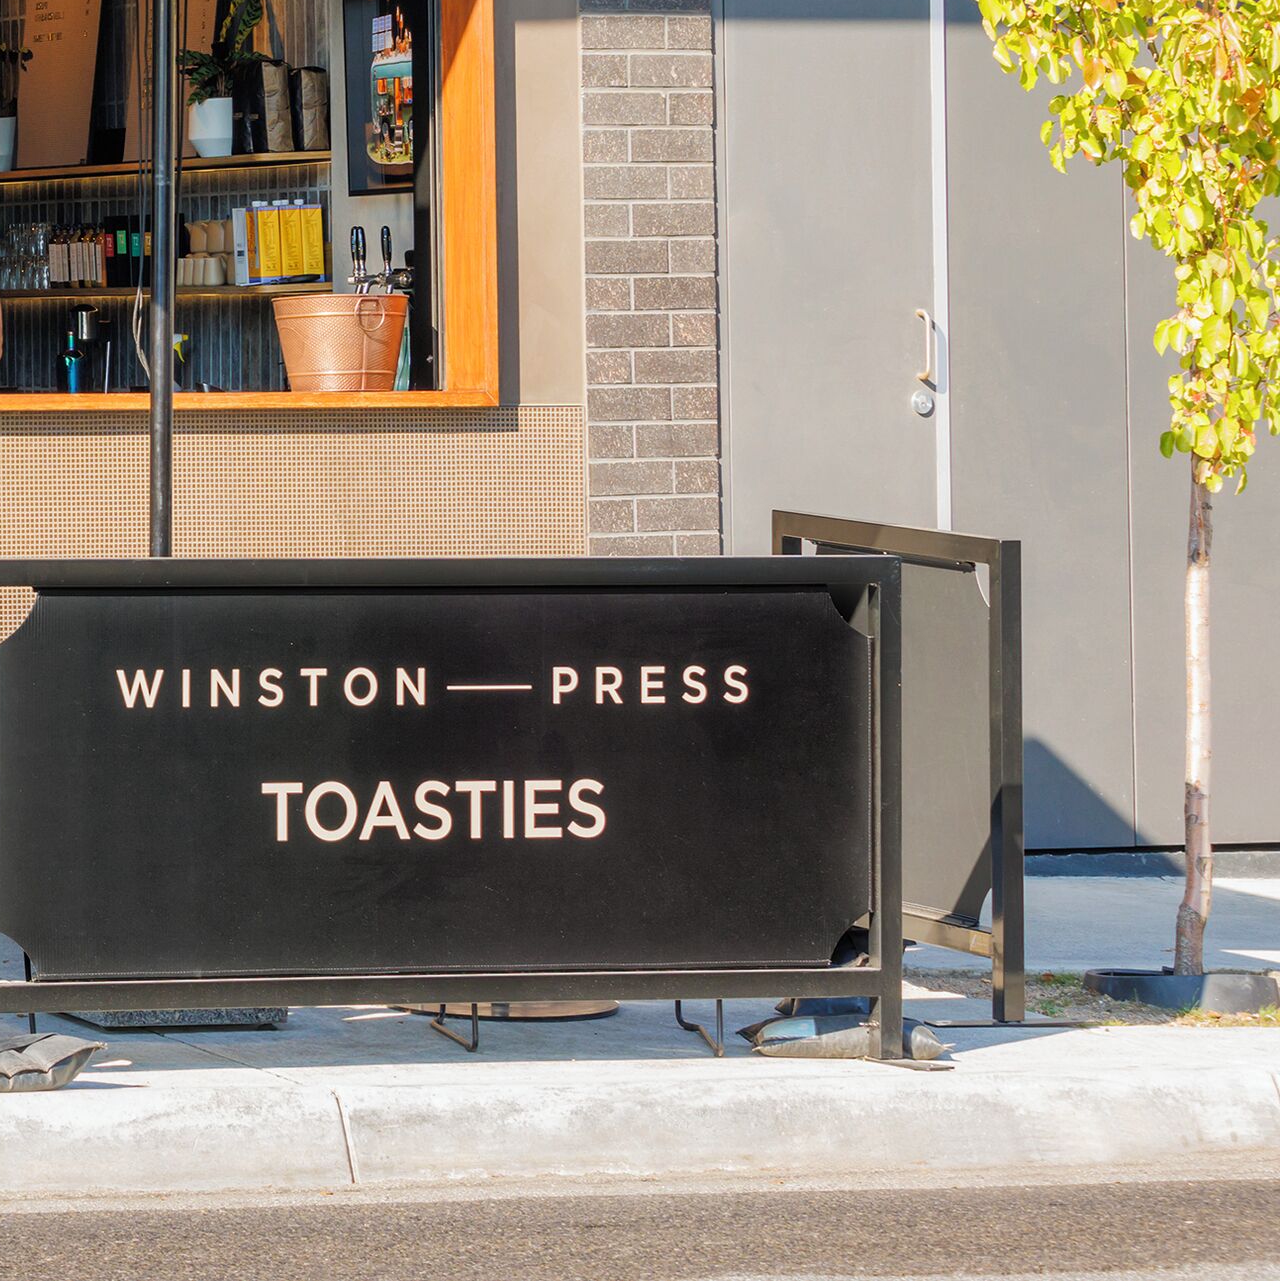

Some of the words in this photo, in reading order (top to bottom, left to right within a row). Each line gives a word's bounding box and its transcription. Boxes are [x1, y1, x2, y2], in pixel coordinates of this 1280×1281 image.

[116, 667, 427, 709] WINSTON
[552, 665, 750, 705] PRESS
[261, 778, 607, 842] TOASTIES
